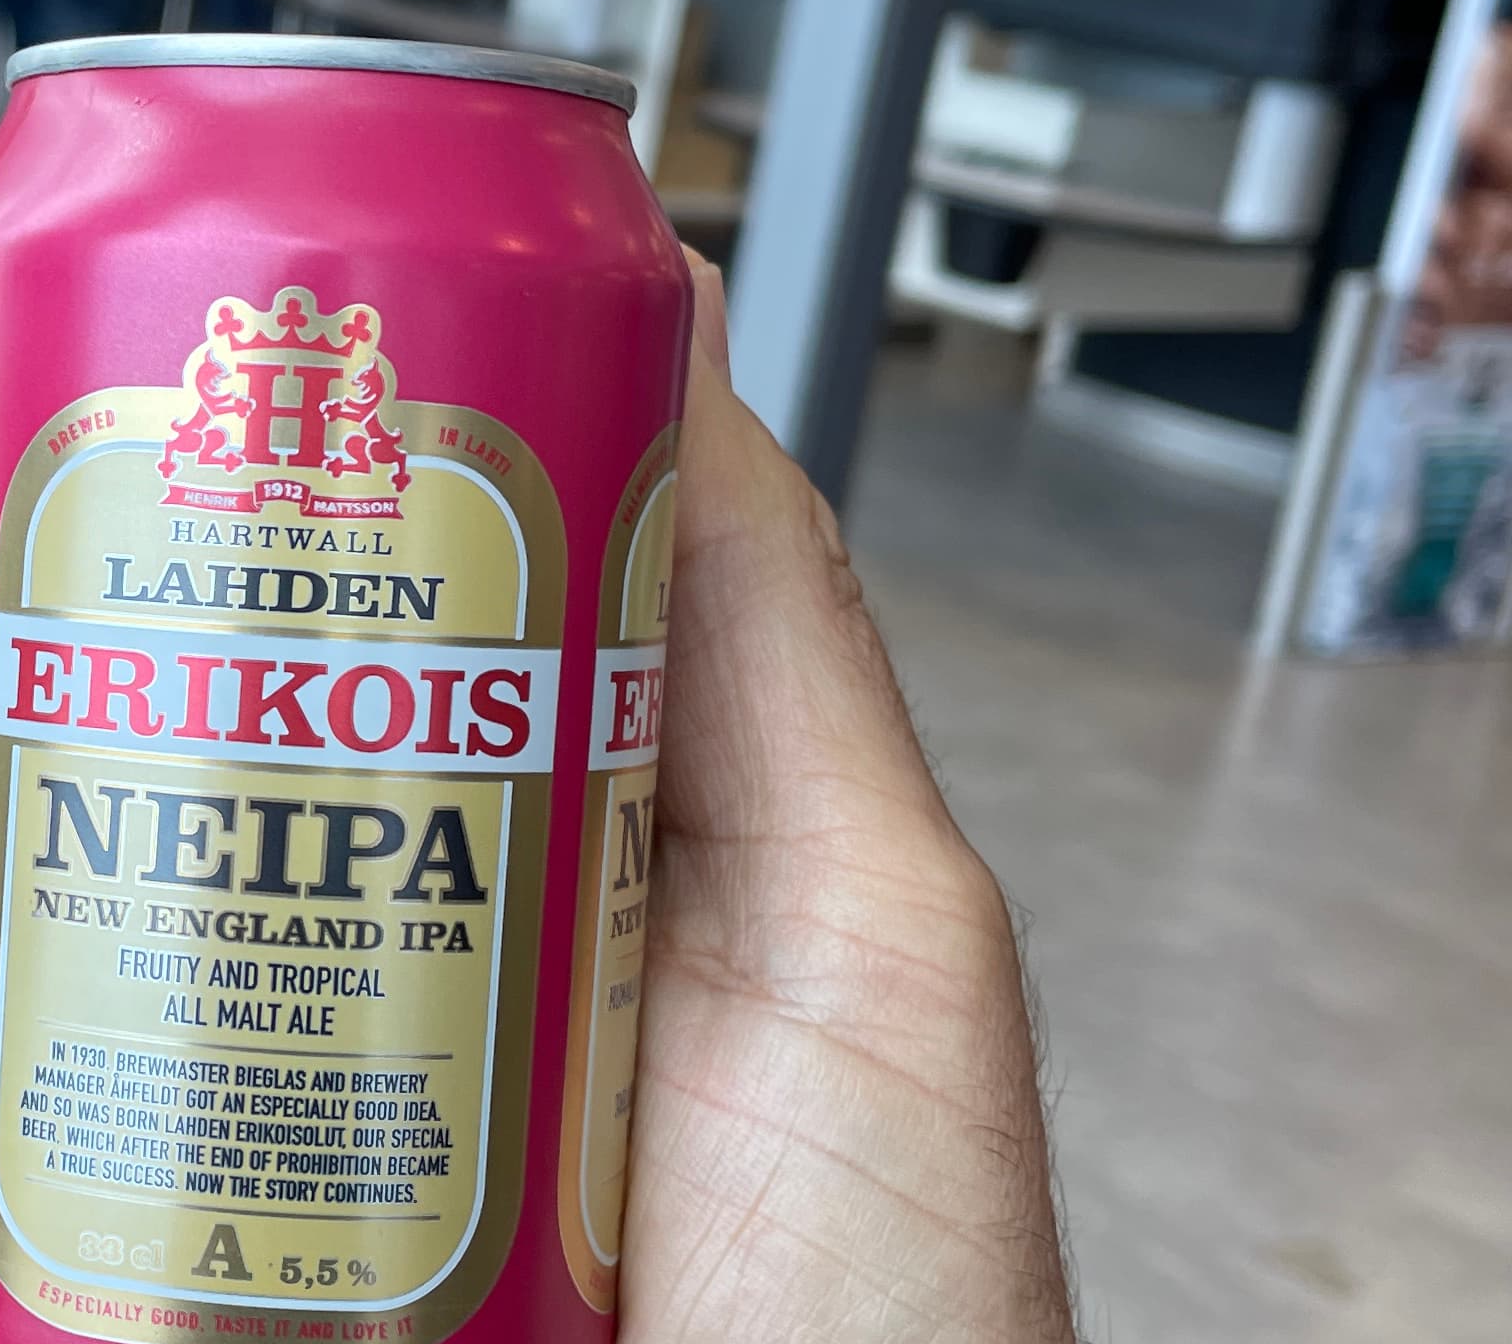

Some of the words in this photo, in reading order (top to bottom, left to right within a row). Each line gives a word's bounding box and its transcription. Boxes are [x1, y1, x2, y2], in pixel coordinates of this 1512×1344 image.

[47, 408, 116, 456] BREWED
[438, 426, 459, 445] IN
[464, 434, 513, 476] LAHTI
[184, 491, 238, 507] HENRIK
[263, 482, 303, 500] 1912
[313, 499, 394, 515] MATTSSON
[171, 520, 392, 555] HARTWALL
[103, 556, 444, 621] LAHDEN
[6, 637, 531, 758] ERIKOIS
[33, 775, 488, 905] NEIPA
[32, 888, 131, 930] NEW
[145, 903, 384, 949] ENGLAND
[400, 920, 473, 953] IPA
[118, 947, 201, 985] FRUITY
[208, 958, 258, 990] AND
[267, 962, 385, 998] TROPICAL
[163, 993, 207, 1026] ALL
[217, 999, 282, 1033] MALT
[286, 1004, 335, 1036] ALE
[34, 1064, 105, 1096] MANAGER
[110, 1072, 181, 1106] ÅHFELDT
[186, 1088, 217, 1110] GOT
[222, 1092, 245, 1115] AN
[250, 1094, 349, 1121] ESPECIALLY
[354, 1100, 398, 1121] GOOD
[404, 1101, 441, 1122] IDEA.
[51, 1040, 65, 1061] IN
[116, 1051, 229, 1085] BREWMASTER
[235, 1065, 306, 1090] BIEGLAS
[310, 1071, 345, 1093] AND
[351, 1072, 429, 1094] BREWERY
[20, 1089, 48, 1113] AND
[53, 1096, 72, 1117] SO
[78, 1100, 110, 1124] WAS
[116, 1106, 159, 1131] BORN
[165, 1113, 230, 1141] LAHDEN
[235, 1121, 347, 1150] ERIKOISOLUT,
[353, 1127, 385, 1149] OUR
[391, 1127, 453, 1149] SPECIAL
[46, 1149, 56, 1169] A
[60, 1152, 97, 1177] TRUE
[102, 1160, 179, 1190] SUCCESS.
[185, 1171, 224, 1195] NOW
[229, 1175, 260, 1199] THE
[265, 1179, 319, 1203] STORY
[324, 1182, 418, 1204] CONTINUES.
[66, 1125, 115, 1153] WHICH
[120, 1135, 169, 1161] AFTER
[176, 1142, 205, 1165] THE
[211, 1146, 244, 1170] END
[249, 1150, 272, 1172] OF
[276, 1151, 381, 1176] PROHIBITION
[388, 1154, 450, 1176] BECAME
[78, 1231, 125, 1266] 33
[130, 1239, 166, 1272] cl
[190, 1223, 253, 1281] A
[280, 1256, 339, 1289] 5,5
[39, 1281, 143, 1323] ESPECIALLY
[213, 1313, 266, 1337] TASTE
[275, 1319, 290, 1338] IT
[297, 1321, 334, 1340] AND
[342, 1320, 388, 1341] LOVE
[397, 1315, 413, 1336] IT
